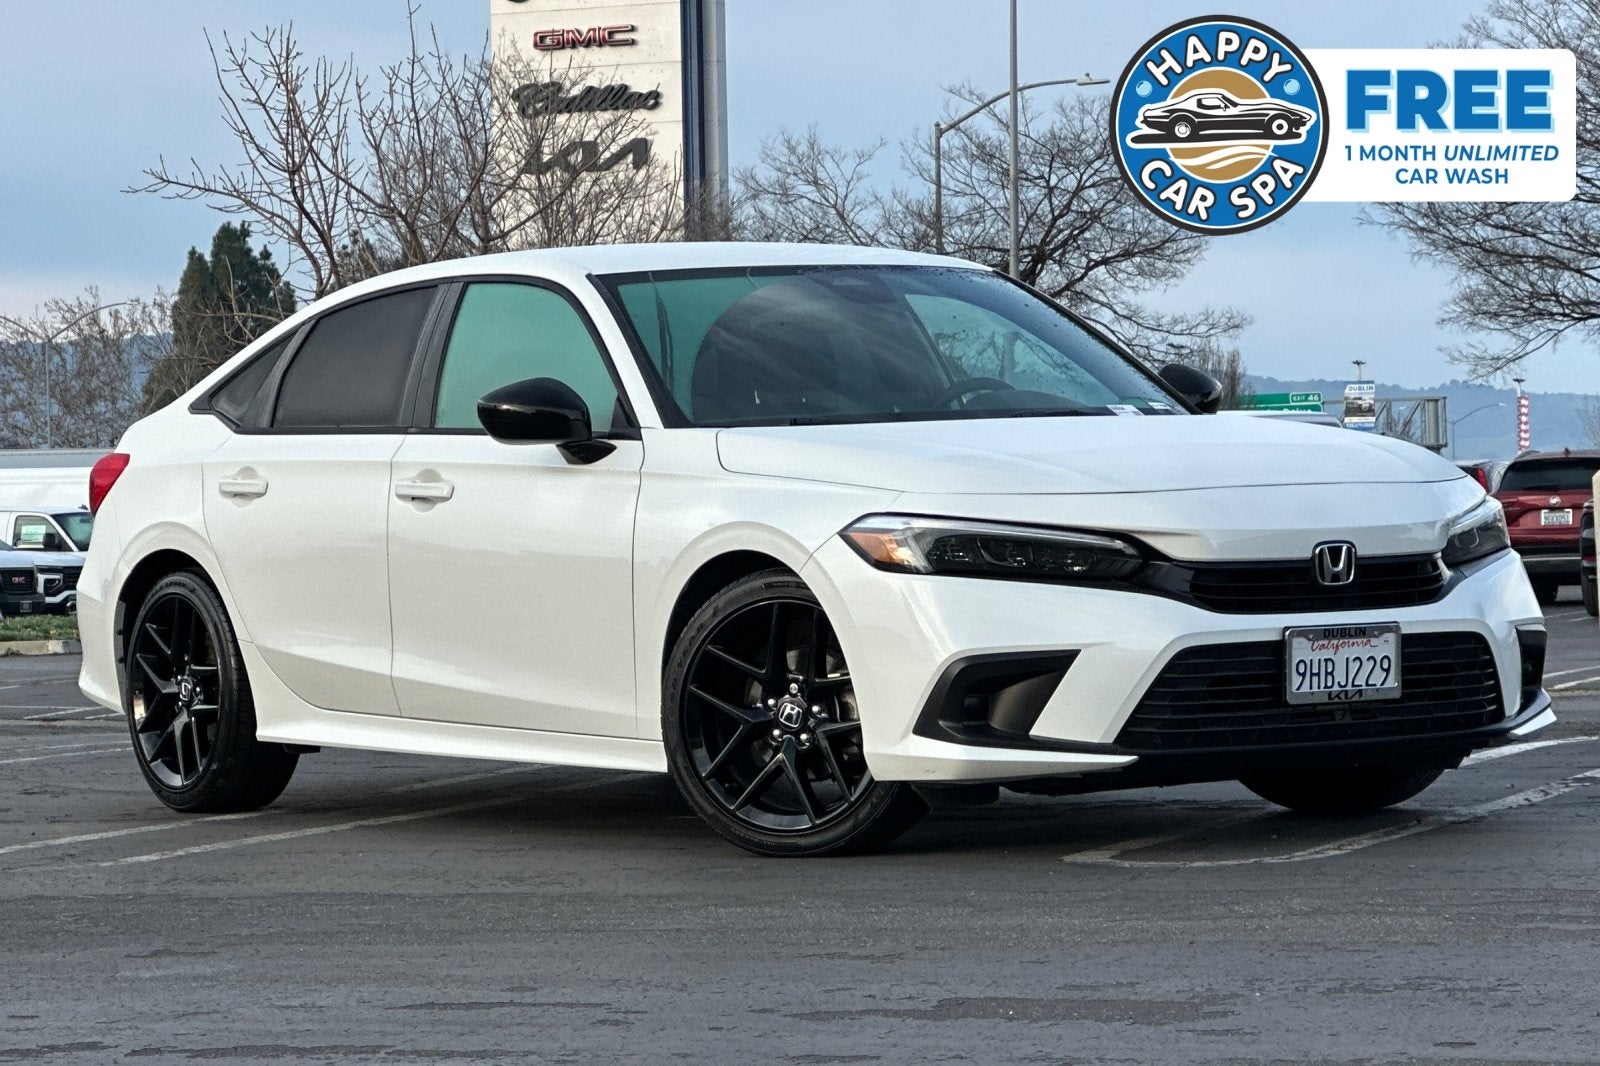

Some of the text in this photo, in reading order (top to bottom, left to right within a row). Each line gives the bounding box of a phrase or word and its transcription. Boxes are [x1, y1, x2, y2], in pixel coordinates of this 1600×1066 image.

[533, 24, 635, 50] GMC
[1323, 627, 1367, 638] DUBLIN
[1311, 639, 1378, 655] California
[1295, 655, 1391, 691] 9HBJ229
